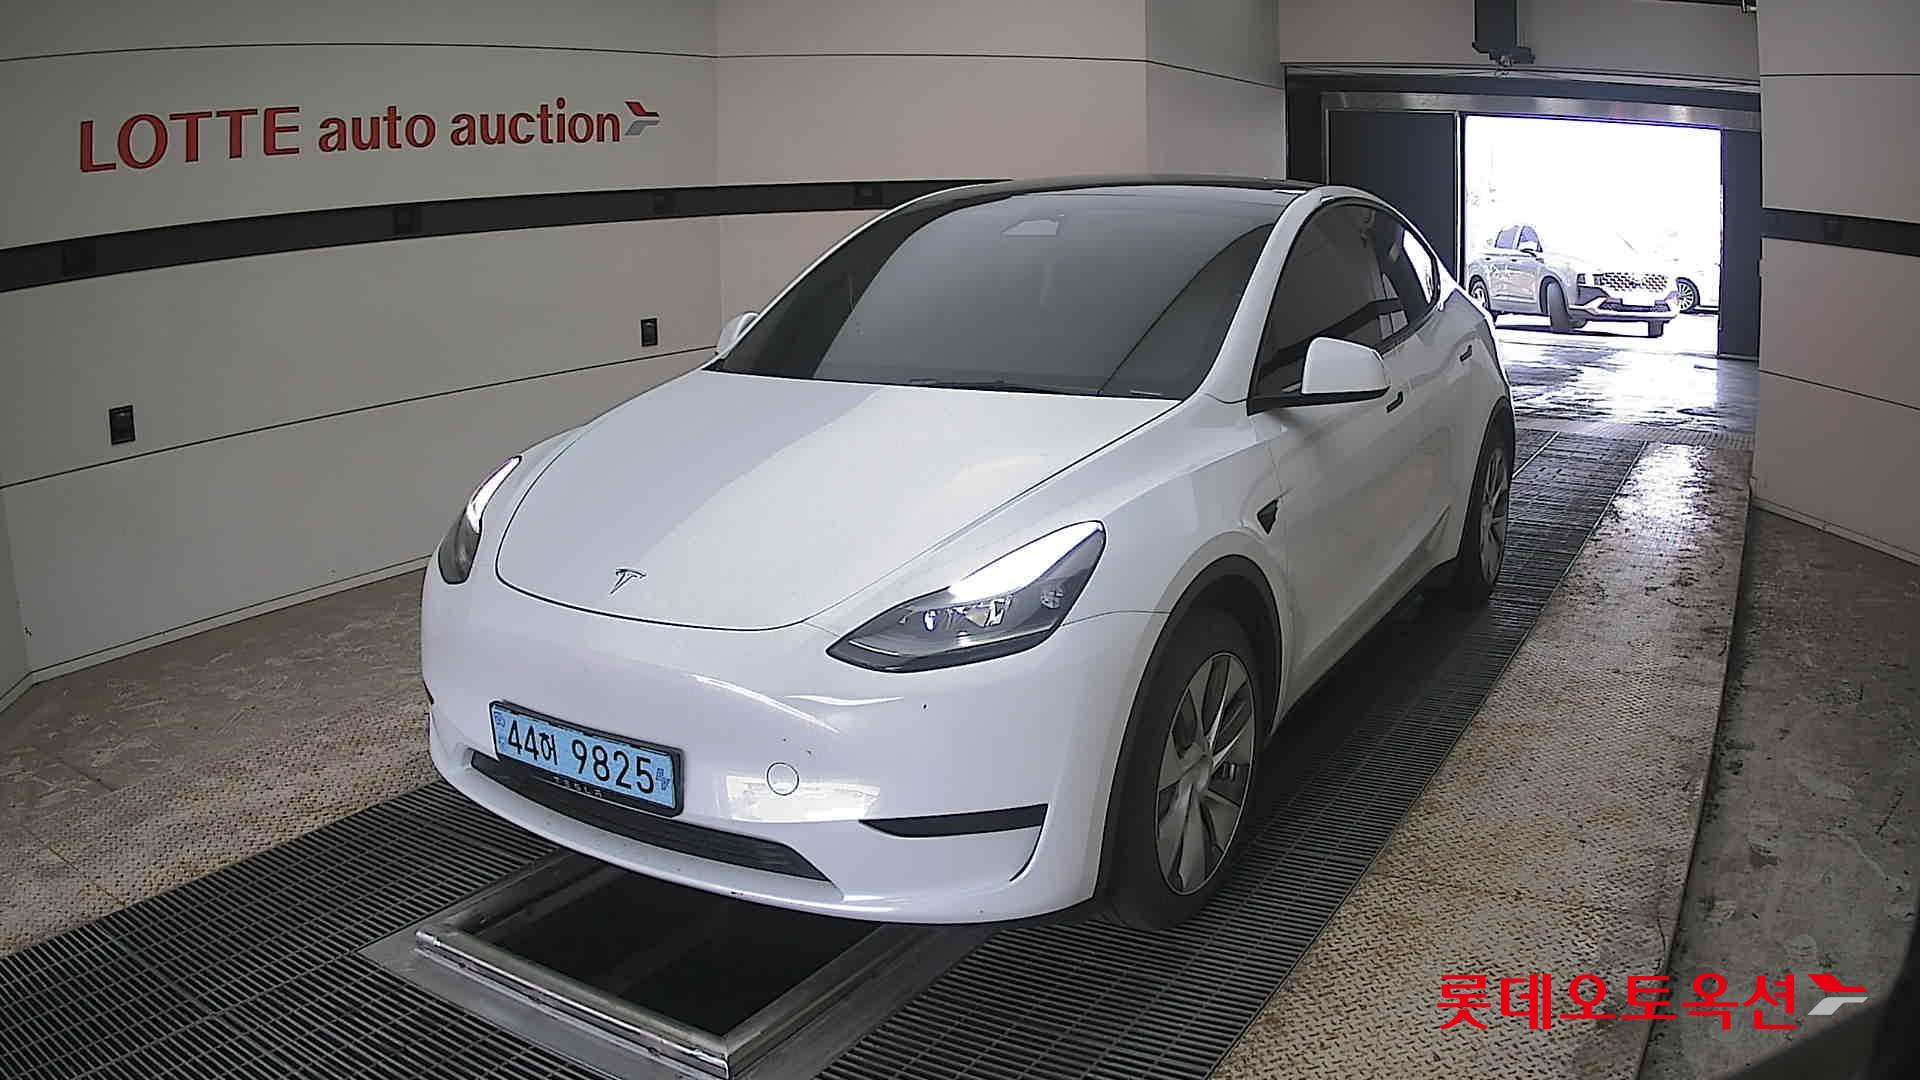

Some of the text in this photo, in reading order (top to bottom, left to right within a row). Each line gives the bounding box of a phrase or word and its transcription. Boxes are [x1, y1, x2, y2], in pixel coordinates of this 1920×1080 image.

[79, 97, 621, 173] LOTTE auto auction
[507, 719, 655, 795] 44허 9825
